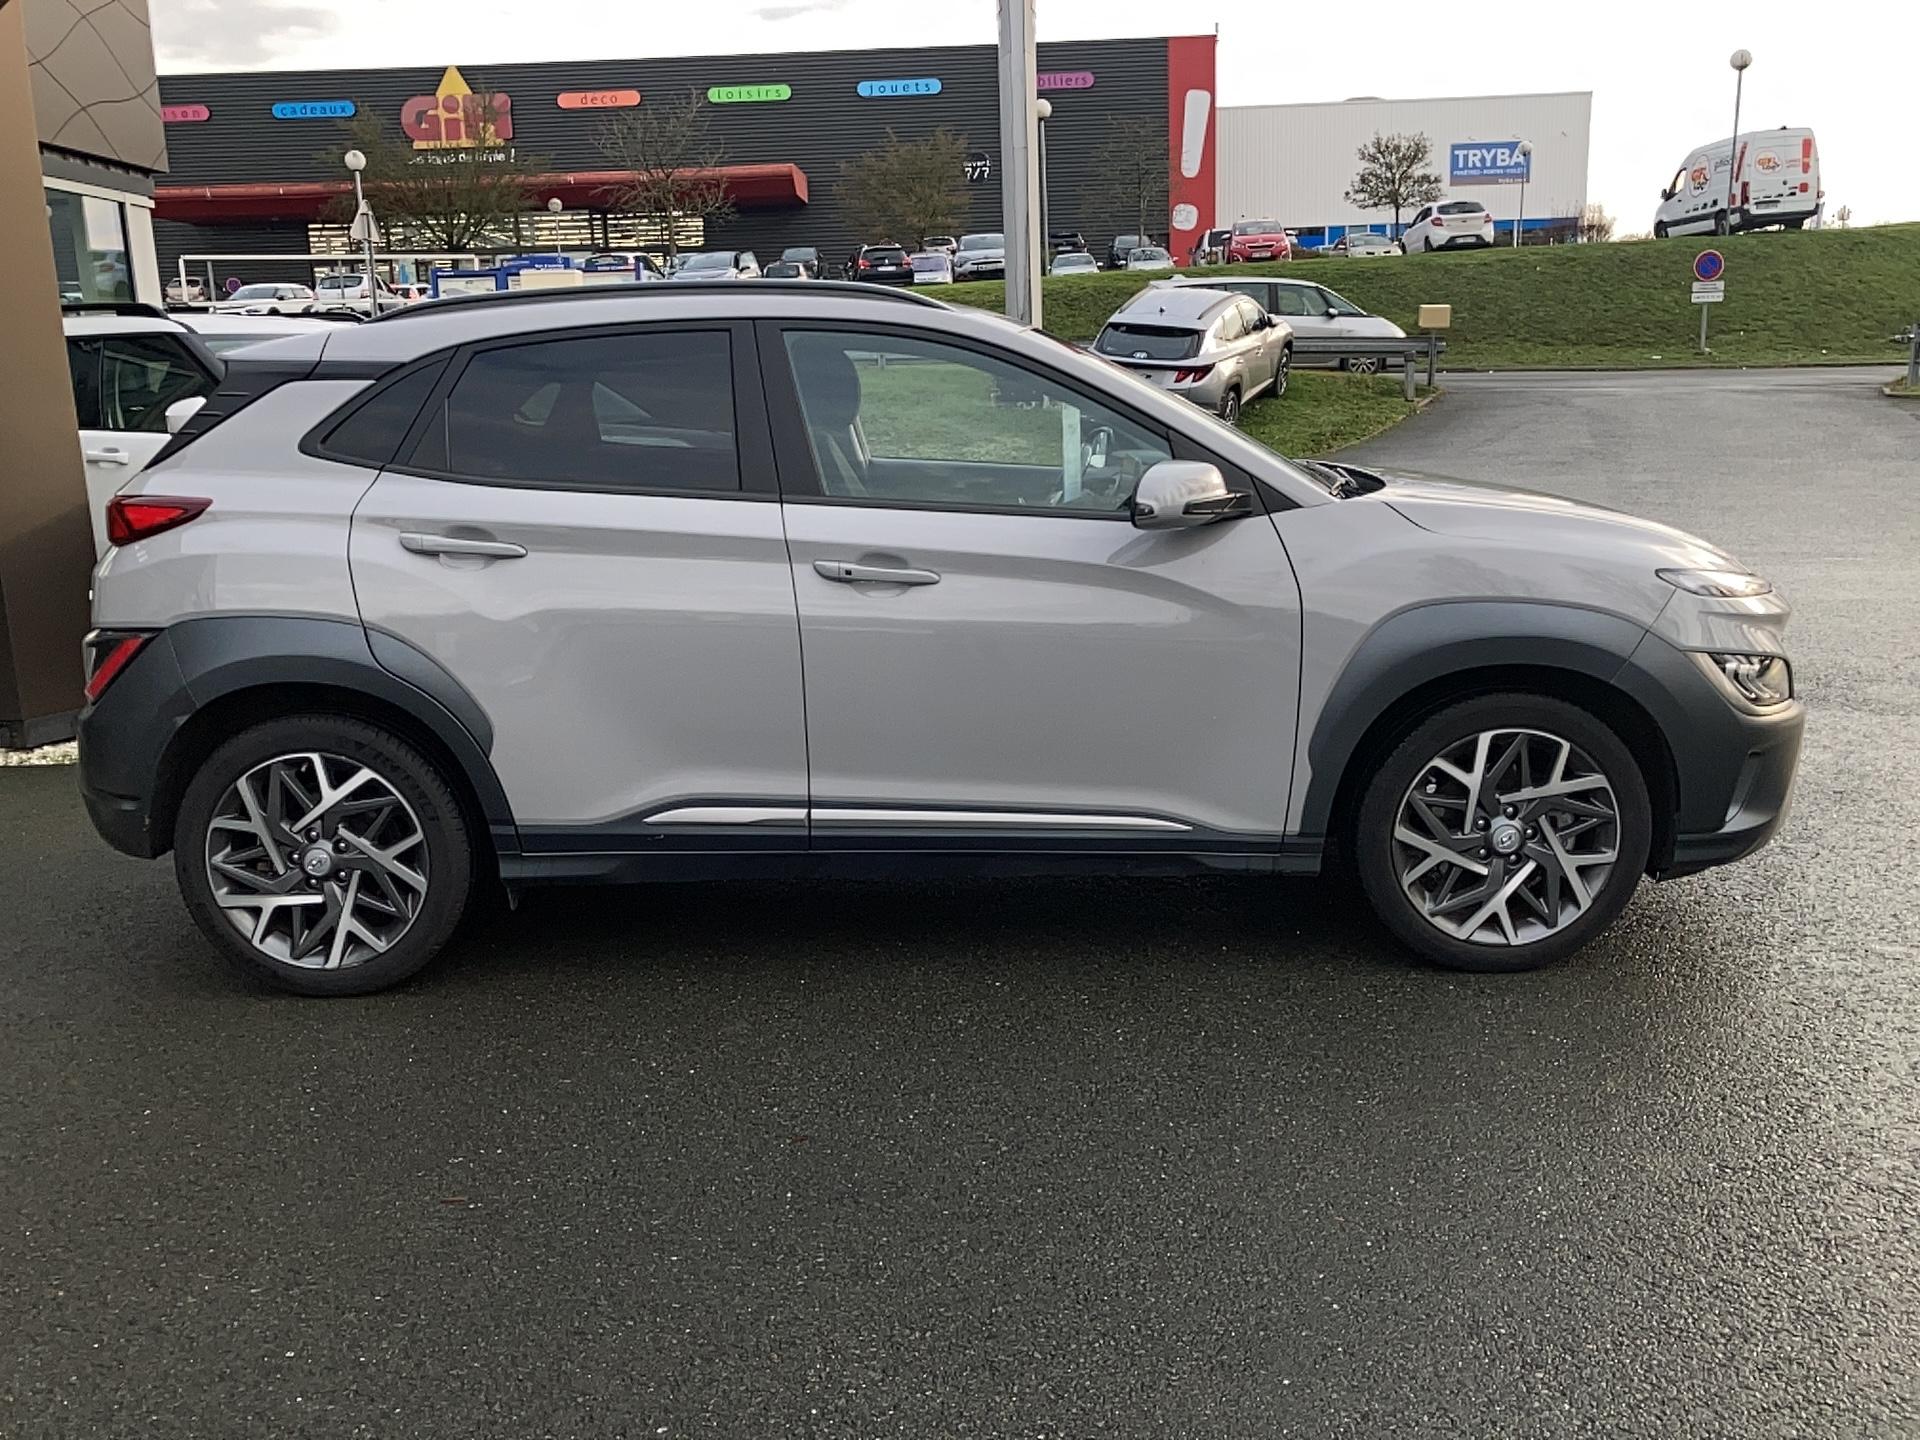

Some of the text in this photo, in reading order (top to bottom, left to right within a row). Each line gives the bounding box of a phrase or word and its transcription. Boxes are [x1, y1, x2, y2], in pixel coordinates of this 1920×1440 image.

[1037, 73, 1089, 87] biliers
[717, 86, 783, 100] loisirs
[868, 80, 931, 96] jouets
[579, 93, 618, 106] deco
[162, 105, 201, 119] ison
[279, 103, 349, 117] cadeaux
[1454, 144, 1525, 168] TRYBA
[965, 167, 990, 179] 7/7
